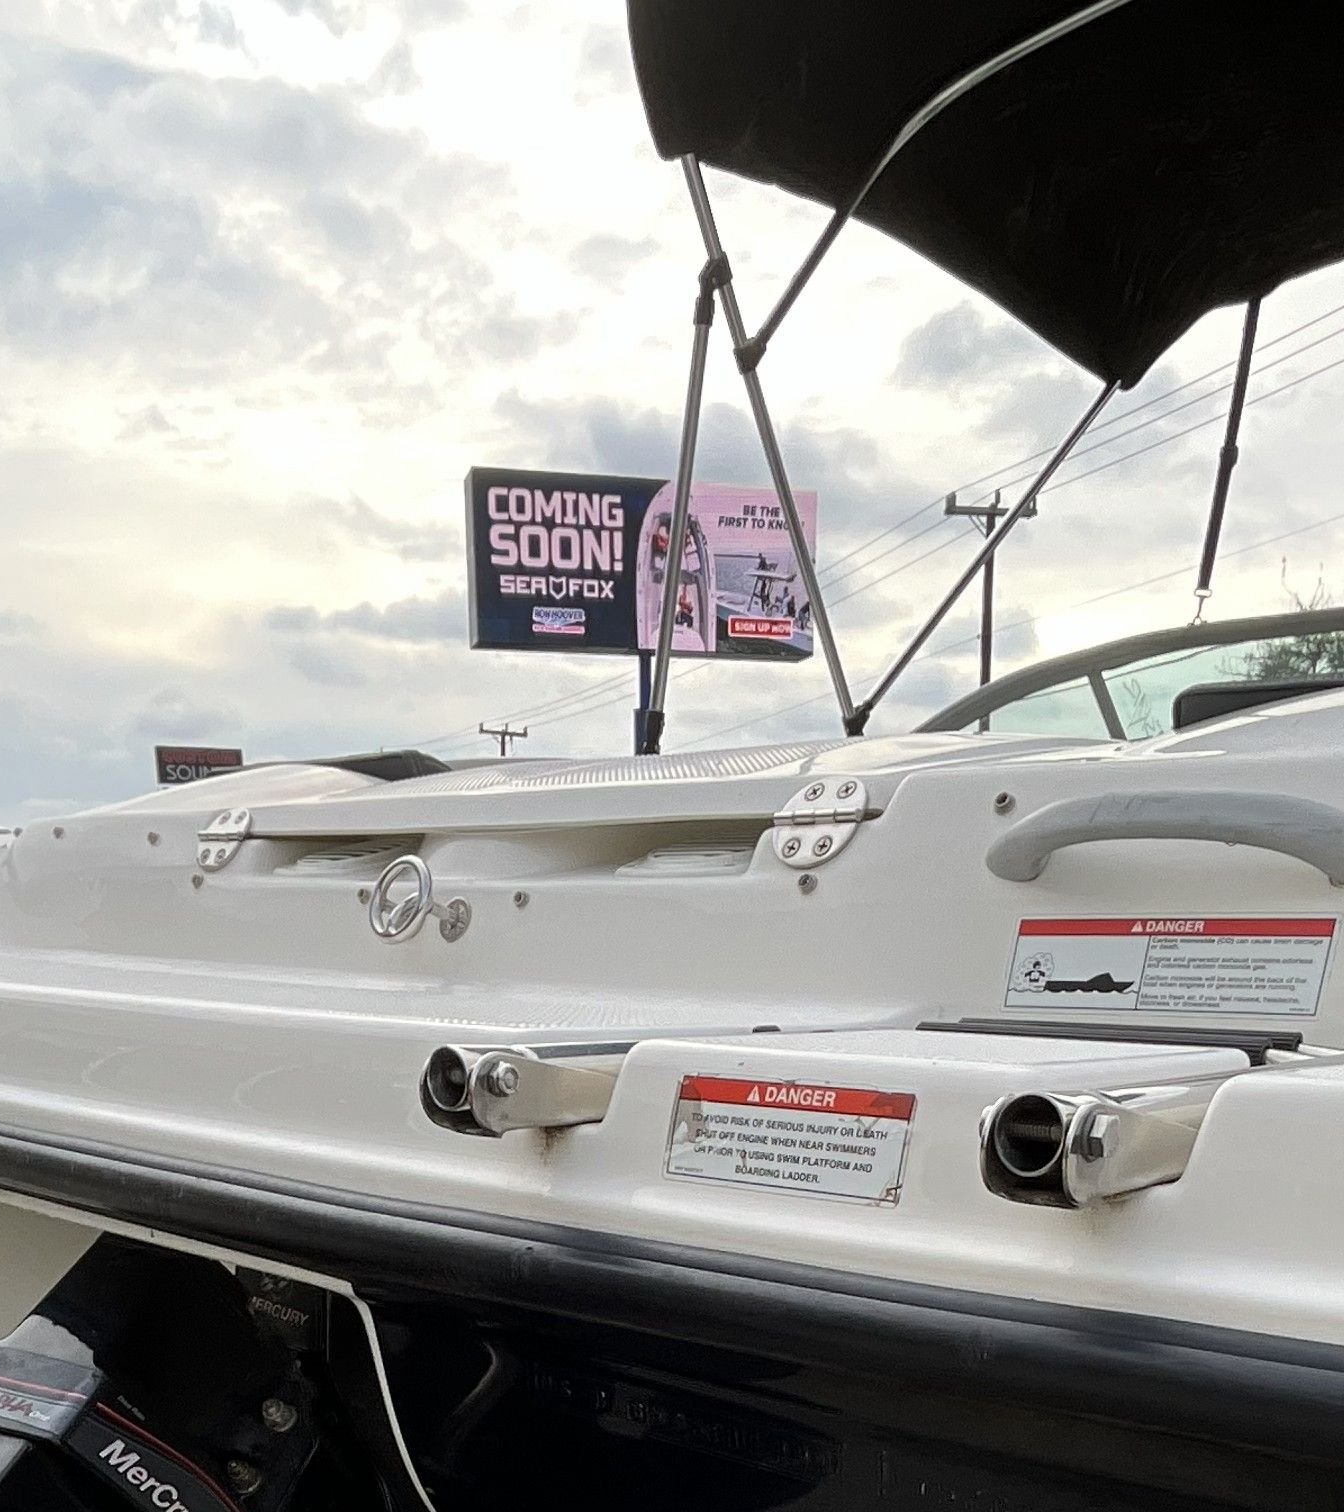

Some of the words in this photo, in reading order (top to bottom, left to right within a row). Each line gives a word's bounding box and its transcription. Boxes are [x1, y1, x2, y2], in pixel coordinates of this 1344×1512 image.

[488, 486, 624, 528] COMING
[743, 505, 757, 516] BE
[760, 506, 781, 518] THE
[717, 516, 749, 529] FIRST
[751, 517, 766, 529] TO
[489, 523, 624, 571] SOON!
[499, 574, 547, 595] SEA
[568, 578, 615, 599] FOX
[734, 620, 756, 632] SIGN
[757, 621, 771, 633] UP
[1145, 920, 1205, 933] DANGER
[764, 1085, 836, 1108] DANGER
[692, 1112, 703, 1121] TO
[730, 1116, 750, 1127] RISK
[752, 1118, 764, 1128] OF
[765, 1120, 804, 1132] SERIOUS
[806, 1124, 839, 1136] INJURY
[840, 1127, 854, 1137] OR
[696, 1128, 717, 1139] SHUT
[719, 1131, 736, 1141] OFF
[737, 1133, 769, 1145] ENGINE
[771, 1137, 797, 1148] WHEN
[799, 1140, 824, 1151] NEAR
[826, 1142, 876, 1157] SWIMMERS
[736, 1148, 747, 1159] TO
[748, 1150, 775, 1162] USING
[777, 1153, 800, 1164] SWIM
[802, 1156, 851, 1170] PLATFORM
[852, 1163, 873, 1173] AND
[735, 1165, 780, 1178] BOARDING
[782, 1170, 820, 1183] LADDER.
